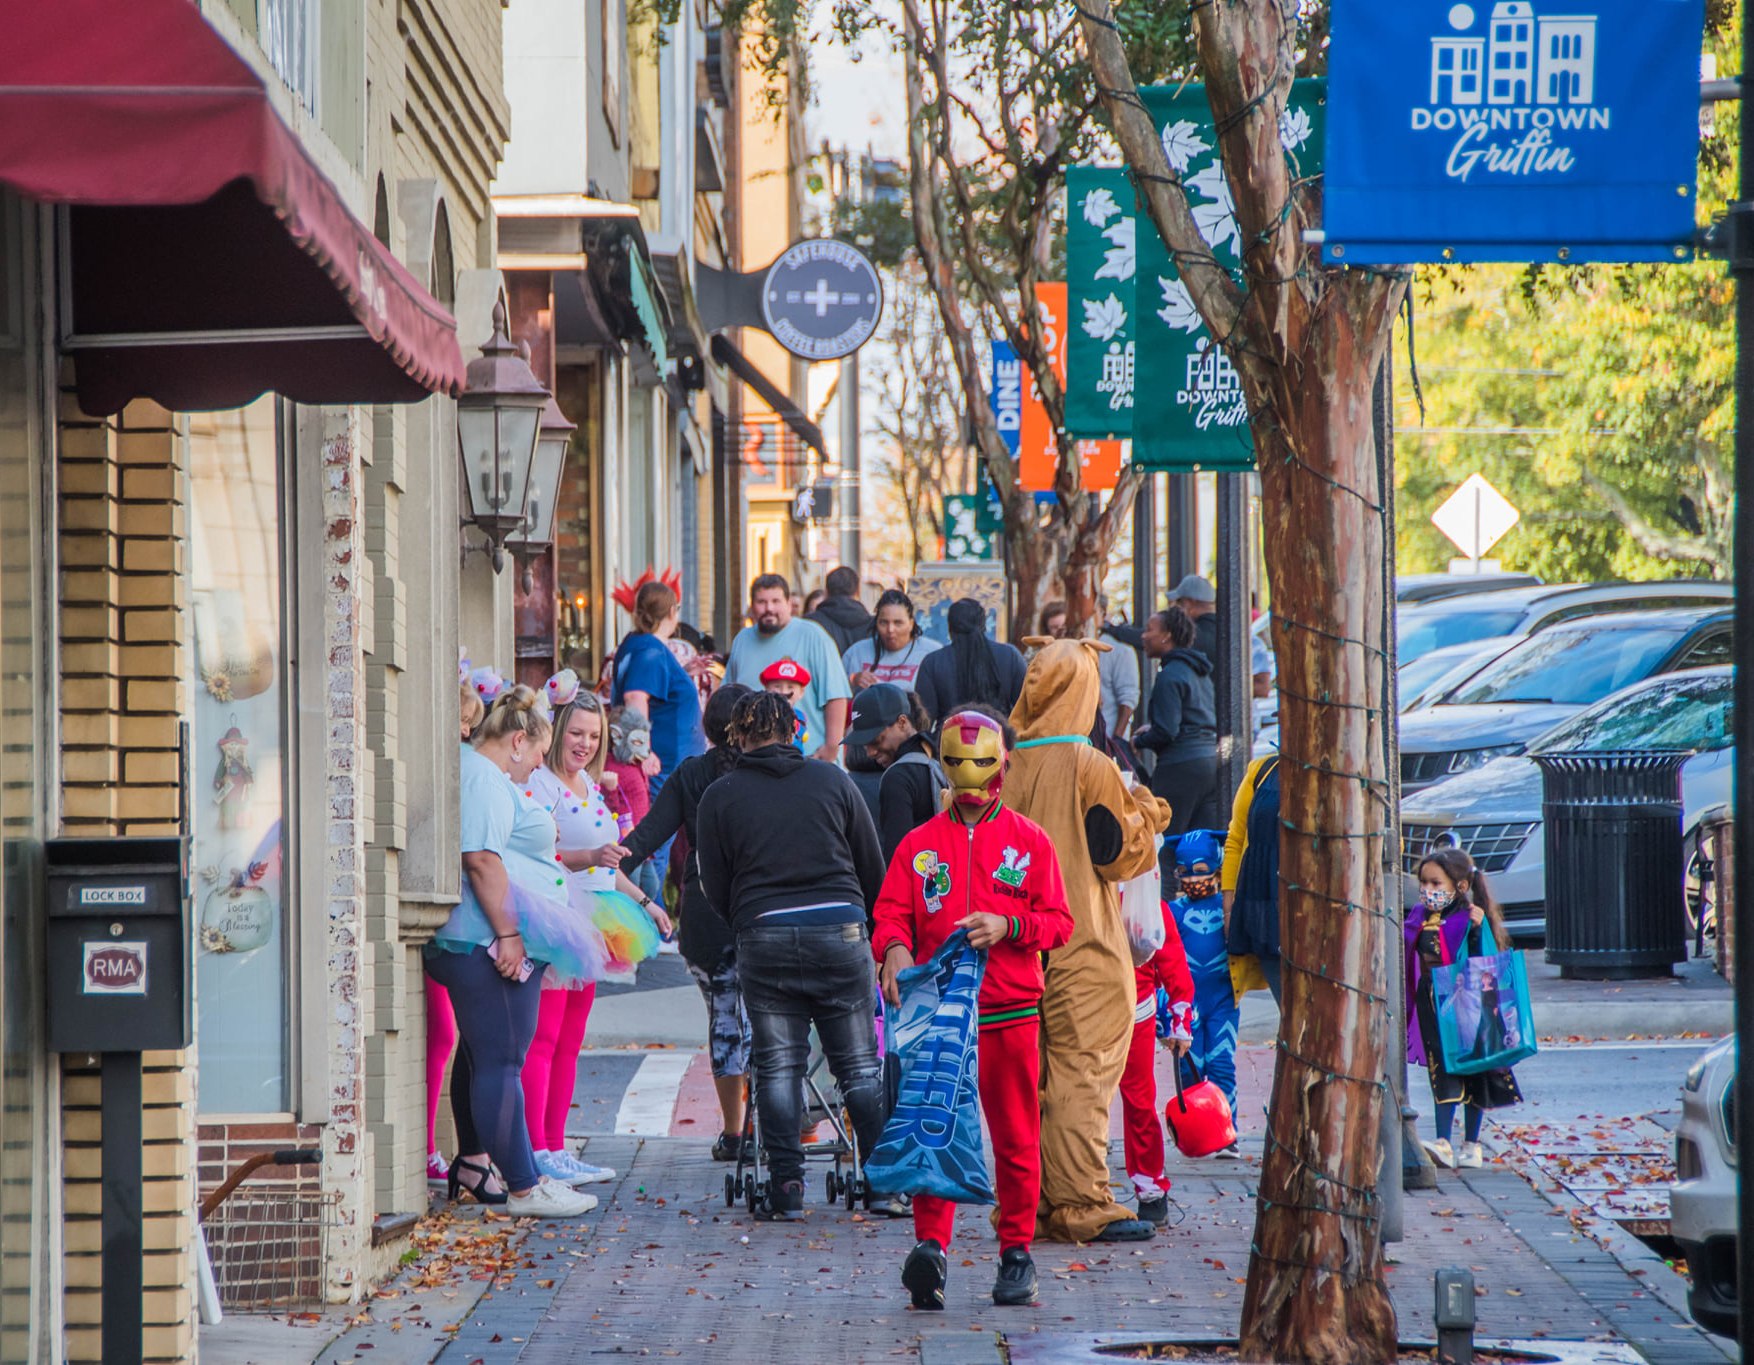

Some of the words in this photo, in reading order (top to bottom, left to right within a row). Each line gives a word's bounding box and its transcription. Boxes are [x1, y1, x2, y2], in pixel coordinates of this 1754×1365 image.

[1411, 108, 1610, 130] DOWNTOWN
[1446, 121, 1576, 183] Griffin
[1096, 380, 1135, 393] DOWN
[997, 359, 1021, 431] DINE
[1176, 389, 1246, 404] DOWNT
[85, 890, 115, 902] LOCK
[118, 889, 142, 901] BOX
[225, 902, 255, 914] Today
[93, 959, 136, 977] RMA
